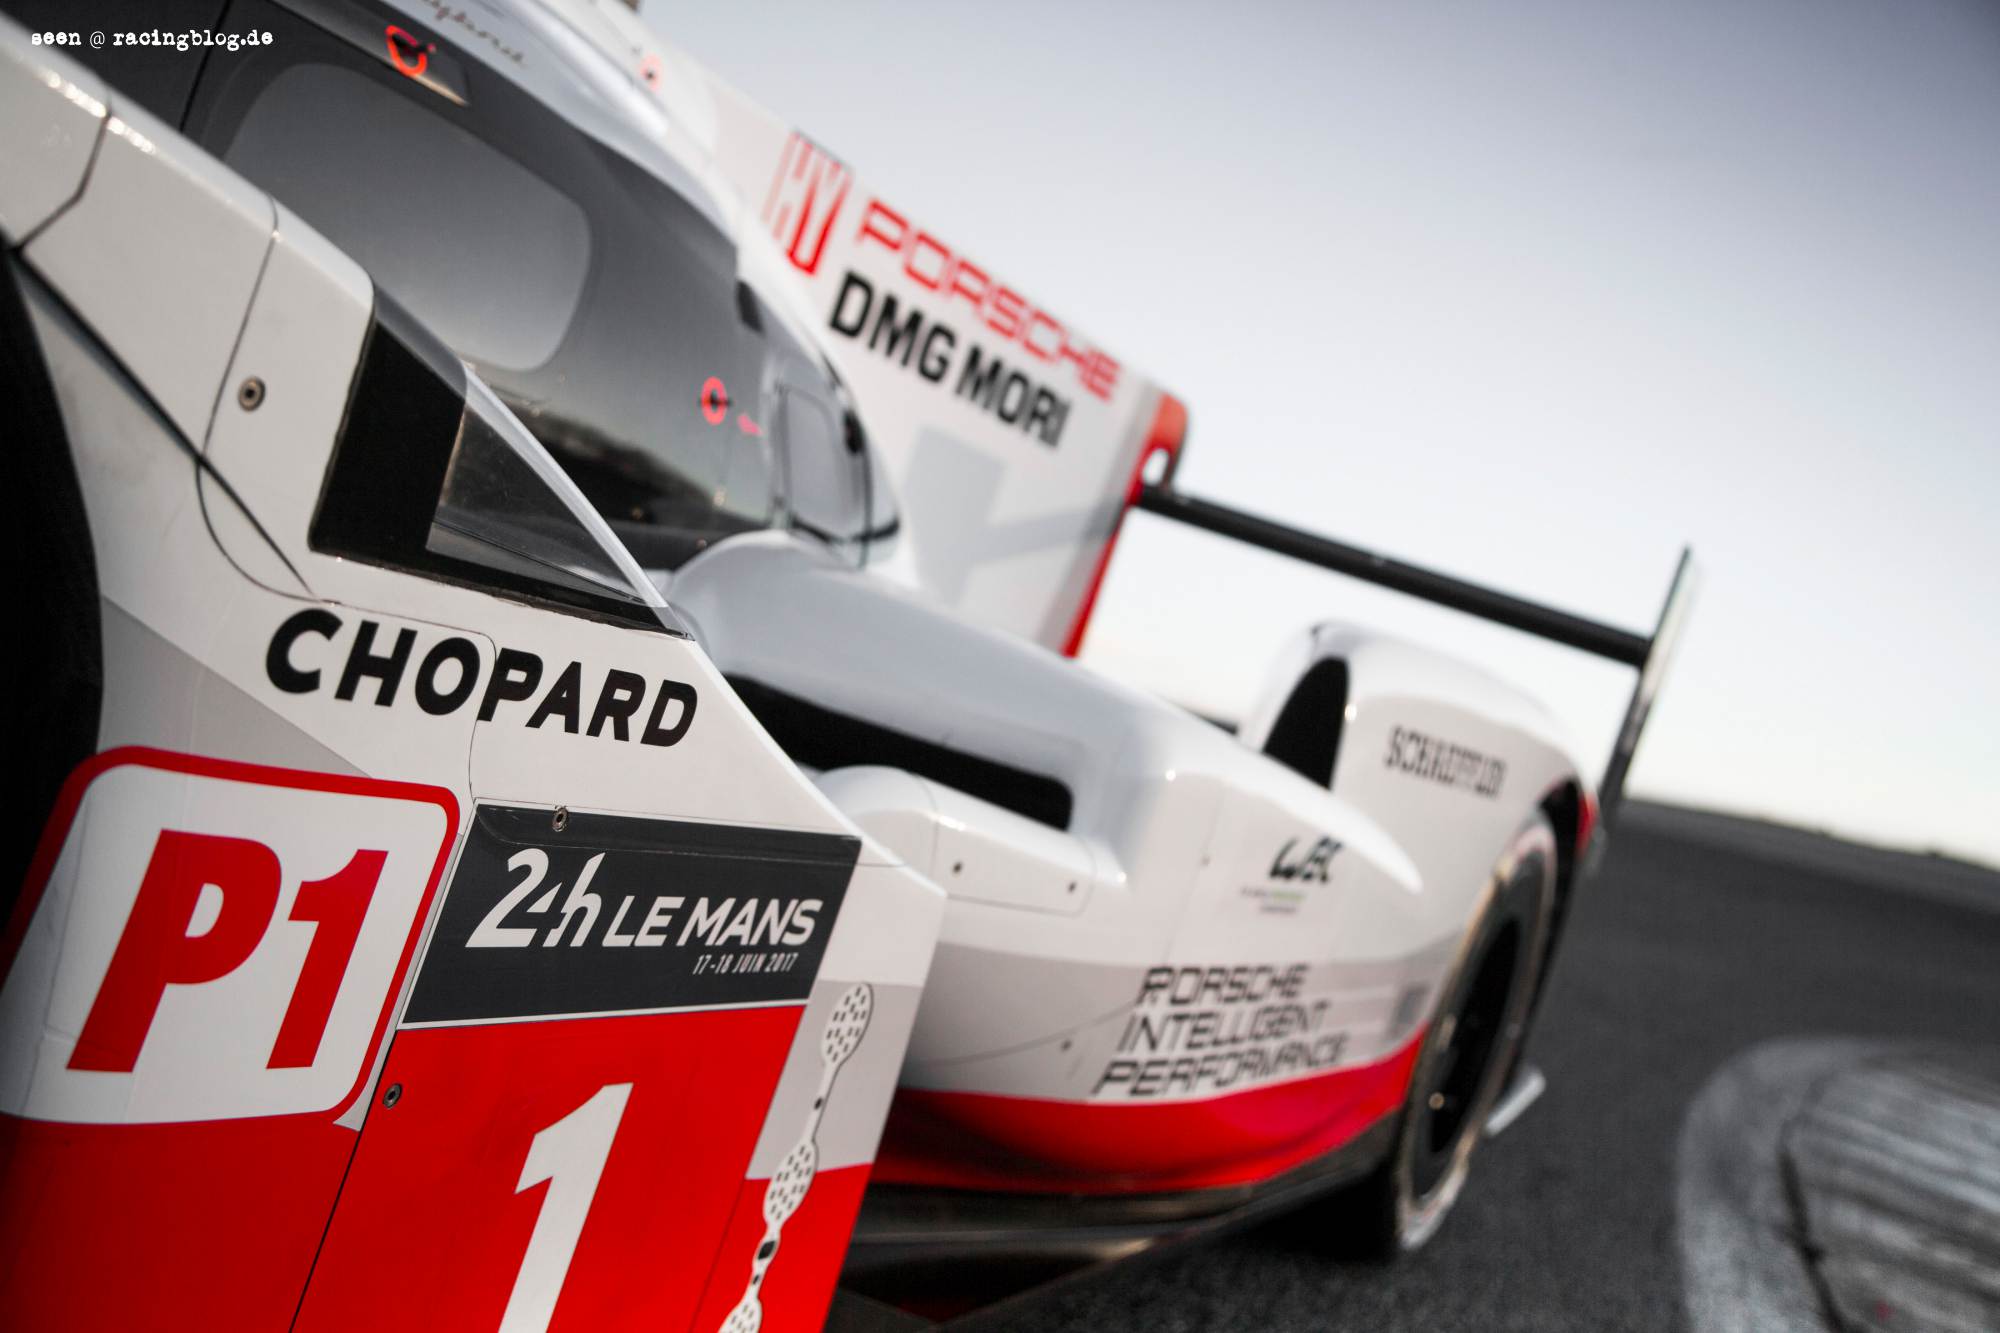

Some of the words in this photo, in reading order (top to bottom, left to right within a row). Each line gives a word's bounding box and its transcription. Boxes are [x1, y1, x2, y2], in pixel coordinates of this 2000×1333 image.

[828, 271, 957, 383] DMG
[954, 345, 1072, 449] MORI
[857, 198, 1121, 403] PORSCHE
[265, 608, 699, 748] CHOPARD
[66, 828, 389, 1073] P1
[465, 848, 606, 948] 24h
[602, 895, 686, 948] LE
[675, 897, 823, 947] MANS
[692, 953, 735, 975] 17-18
[731, 953, 768, 974] JUIN
[764, 951, 799, 973] 2017
[1134, 964, 1309, 1007] PORSCHE
[1090, 1033, 1348, 1096] PERFORMANCE
[1116, 1000, 1331, 1051] INTELLIGENT
[497, 1082, 634, 1333] 1
